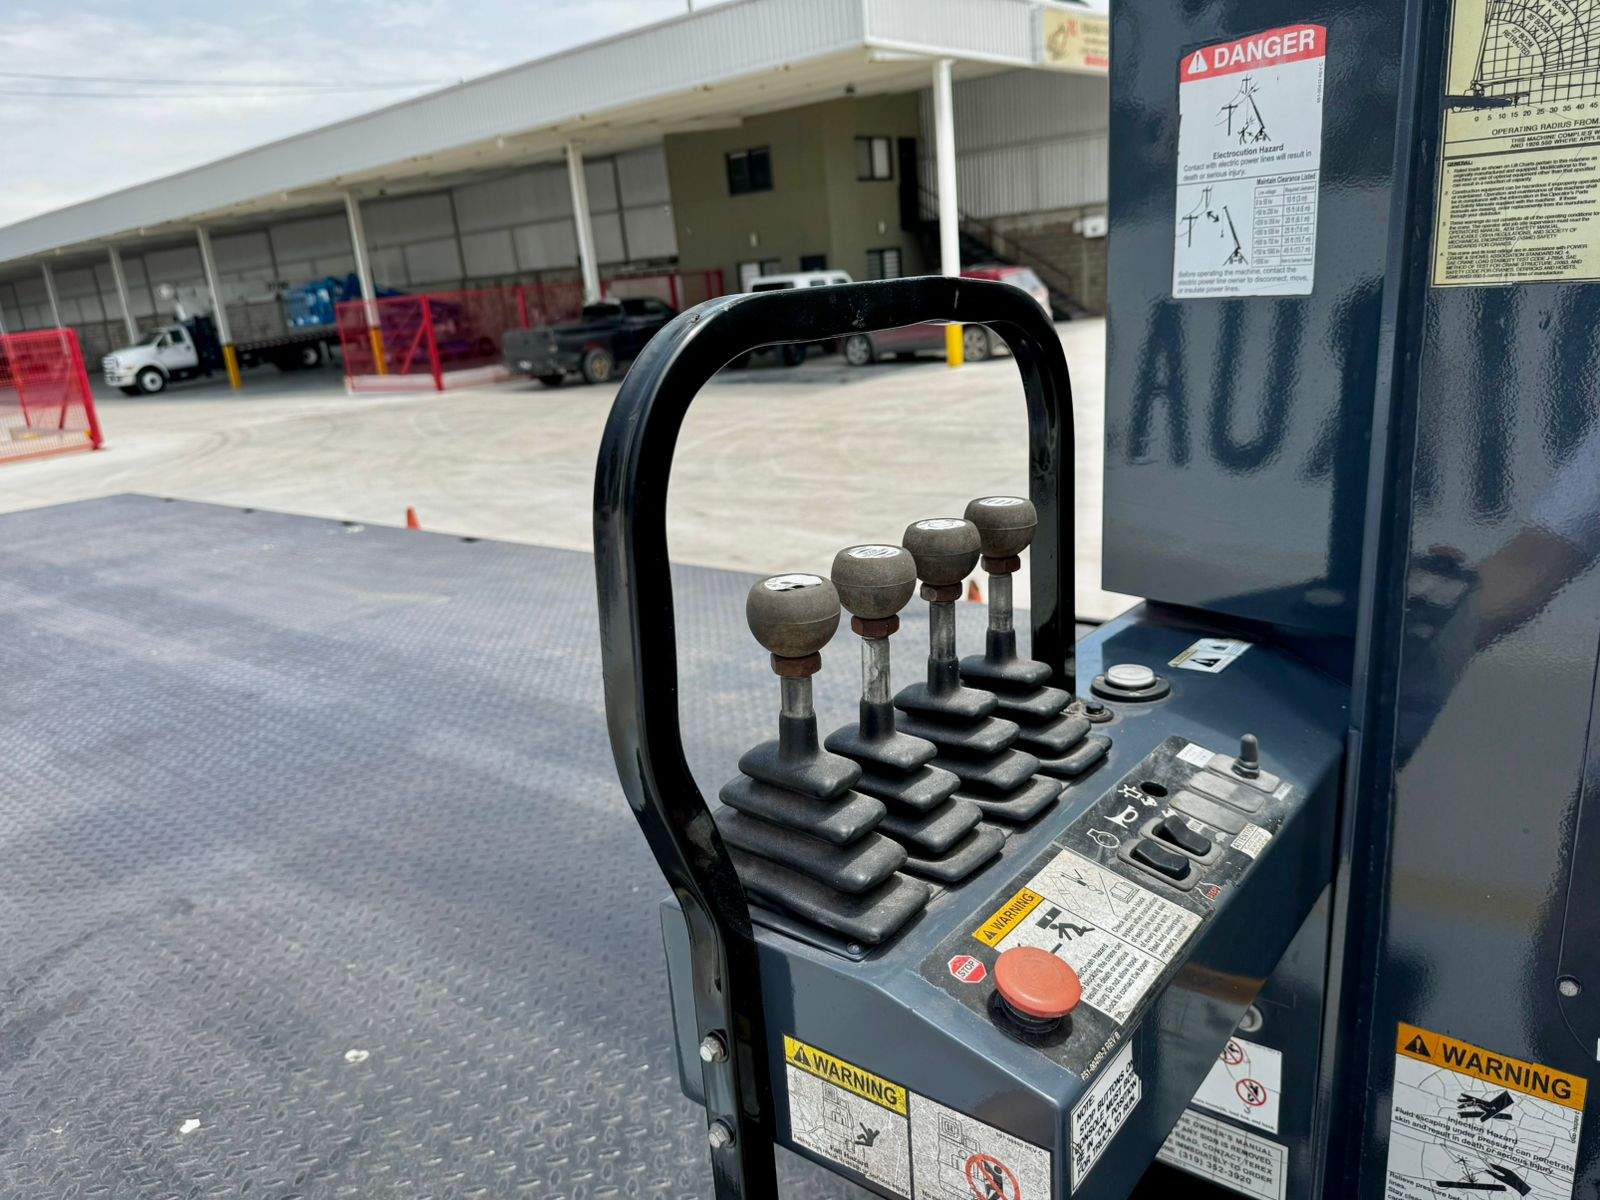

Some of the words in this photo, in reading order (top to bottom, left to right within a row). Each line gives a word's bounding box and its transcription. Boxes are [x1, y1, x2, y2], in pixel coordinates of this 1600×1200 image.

[1533, 19, 1550, 34] BOOM
[1213, 29, 1315, 69] DANGER
[1503, 29, 1531, 56] RETRACTED
[1519, 33, 1535, 48] BOOM
[1492, 125, 1538, 136] OPERATING
[1540, 120, 1571, 130] RADIUS
[1574, 117, 1599, 127] FROM
[1527, 134, 1555, 142] MACHINE
[1558, 130, 1592, 138] COMPLIES
[1184, 163, 1204, 172] Contact
[1241, 157, 1259, 166] power
[1287, 151, 1304, 159] result
[1213, 148, 1257, 159] Electrocution
[1260, 144, 1284, 153] Hazard
[1256, 176, 1276, 185] Maintain
[1277, 175, 1300, 183] Clearance
[990, 892, 1035, 932] WARNING
[1111, 920, 1126, 933] Check
[1132, 896, 1147, 908] block
[1121, 923, 1138, 939] system
[1132, 914, 1144, 925] after
[1133, 927, 1146, 939] each
[1147, 913, 1158, 923] and
[1143, 932, 1157, 945] every
[1152, 922, 1164, 933] work
[1148, 941, 1162, 953] Read
[1156, 933, 1167, 943] and
[1162, 914, 1184, 936] understand
[1091, 943, 1109, 960] Hazard
[1113, 951, 1130, 968] serious
[958, 961, 975, 977] STOP
[1081, 966, 1103, 988] blocking
[1096, 960, 1108, 969] the
[1103, 949, 1118, 963] crane
[1113, 942, 1124, 951] can
[1130, 970, 1141, 980] the
[1136, 959, 1151, 973] boom
[1093, 981, 1104, 989] in
[1098, 970, 1113, 985] death
[1104, 984, 1116, 994] Do
[1110, 977, 1121, 987] not
[1118, 977, 1136, 996] contact
[1084, 986, 1100, 1002] result
[1104, 998, 1119, 1014] block
[1114, 993, 1123, 1001] to
[1104, 1035, 1117, 1051] REV
[813, 1053, 898, 1107] WARNING
[1440, 1043, 1573, 1101] WARNING
[1079, 1106, 1096, 1137] STOP
[1097, 1069, 1125, 1112] BUTTONS
[1106, 1085, 1122, 1114] MUST
[1077, 1148, 1085, 1168] BE
[1087, 1137, 1093, 1153] IN
[1095, 1113, 1110, 1142] "ON"
[1111, 1078, 1136, 1119] POSITION
[1447, 1115, 1485, 1135] Injection
[1486, 1129, 1518, 1145] Hazard
[1078, 1153, 1091, 1179] FOR
[1093, 1124, 1112, 1158] TRUCK
[1114, 1110, 1122, 1128] TO
[1181, 1126, 1198, 1136] ANY
[1198, 1133, 1220, 1145] SIGN
[1219, 1141, 1230, 1149] IS
[1229, 1145, 1274, 1167] REMOVED,
[1192, 1122, 1234, 1141] OWNER'S
[1234, 1138, 1273, 1157] MANUAL
[1394, 1114, 1410, 1125] skin
[1412, 1120, 1425, 1130] and
[1426, 1125, 1451, 1139] result
[1451, 1133, 1460, 1142] in
[1461, 1137, 1485, 1151] death
[1496, 1150, 1528, 1166] serious
[1395, 1106, 1414, 1118] Fluid
[1415, 1113, 1451, 1132] escaping
[1452, 1126, 1476, 1139] under
[1477, 1135, 1515, 1154] pressure
[1515, 1147, 1531, 1158] can
[1532, 1154, 1576, 1174] penetrate
[830, 1144, 842, 1156] Fall
[843, 1151, 869, 1169] Hazard
[1173, 1140, 1229, 1166] IMMEDIATELY
[1229, 1162, 1241, 1172] TO
[1242, 1168, 1273, 1184] ORDER
[1176, 1150, 1205, 1166] (319)
[1200, 1142, 1240, 1162] CONTACT
[1244, 1158, 1273, 1175] TEREX
[1388, 1186, 1403, 1196] Stay
[1389, 1171, 1414, 1185] Relieve
[1415, 1182, 1447, 1197] pressure
